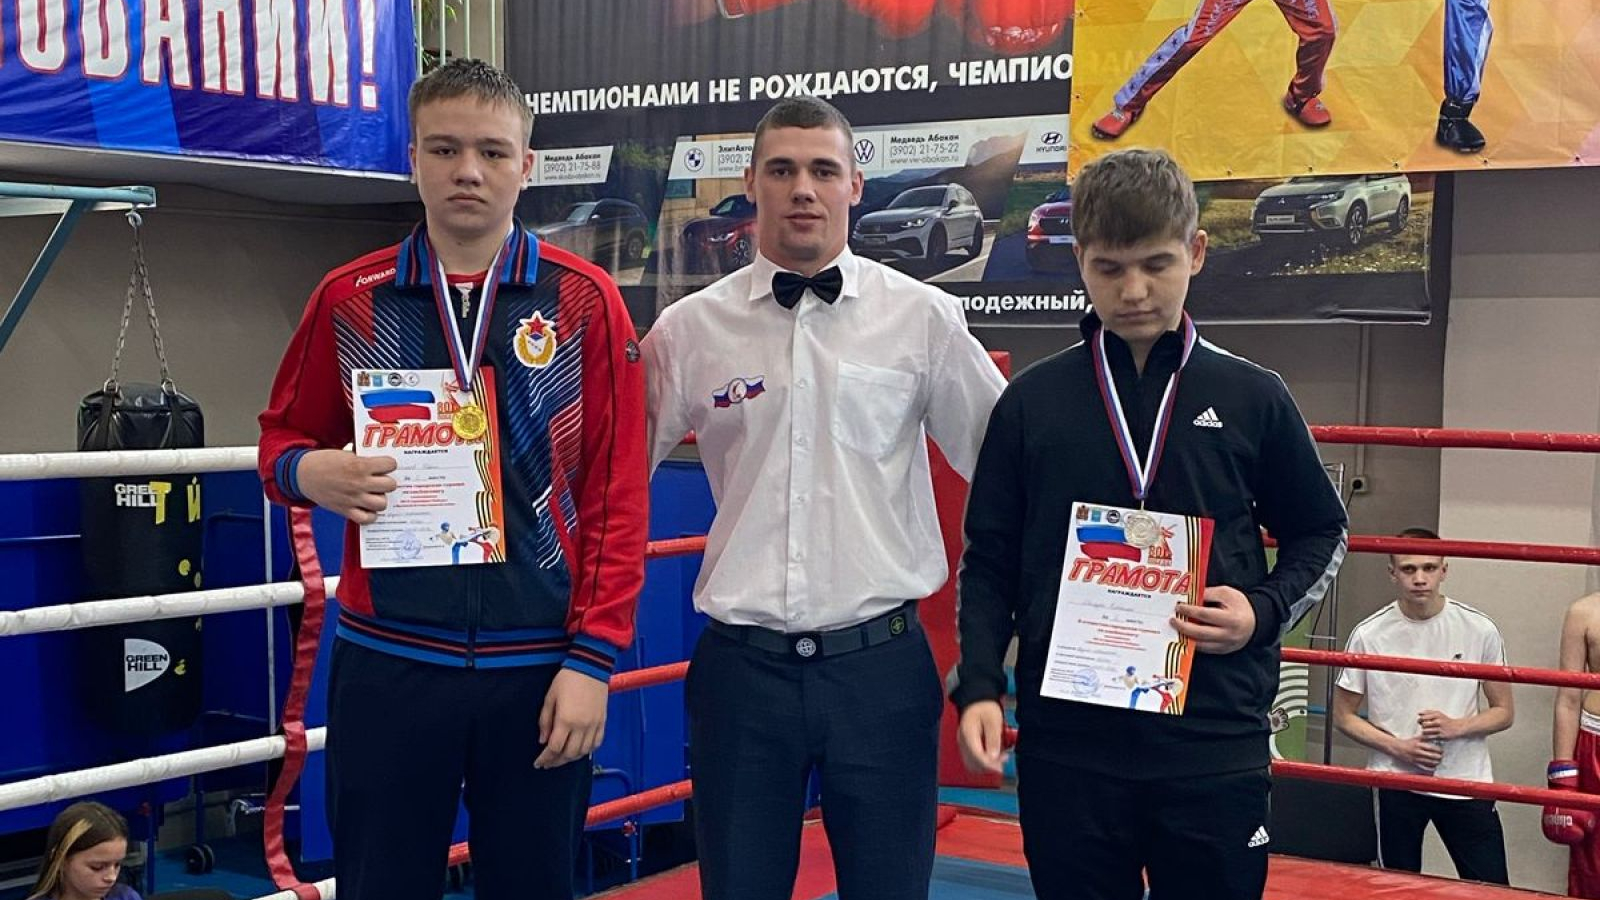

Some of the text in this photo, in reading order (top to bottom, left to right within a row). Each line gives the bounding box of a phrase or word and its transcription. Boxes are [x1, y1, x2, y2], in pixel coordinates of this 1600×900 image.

[525, 53, 1073, 115] ЧЕМПИОНАМИ НЕ РОЖДАЮТСЯ, ЧЕМПИО
[890, 134, 960, 144] Медведь Абакан
[890, 142, 960, 157] (3902) 21-75-22
[544, 154, 573, 162] Медведь
[718, 154, 742, 166] (3902)
[1192, 418, 1223, 428] adidas
[363, 423, 486, 448] ГРАМО
[114, 483, 158, 495] GRE
[1068, 558, 1193, 595] ГРАМОТА
[126, 654, 168, 663] GREEN
[127, 661, 163, 672] HILL
